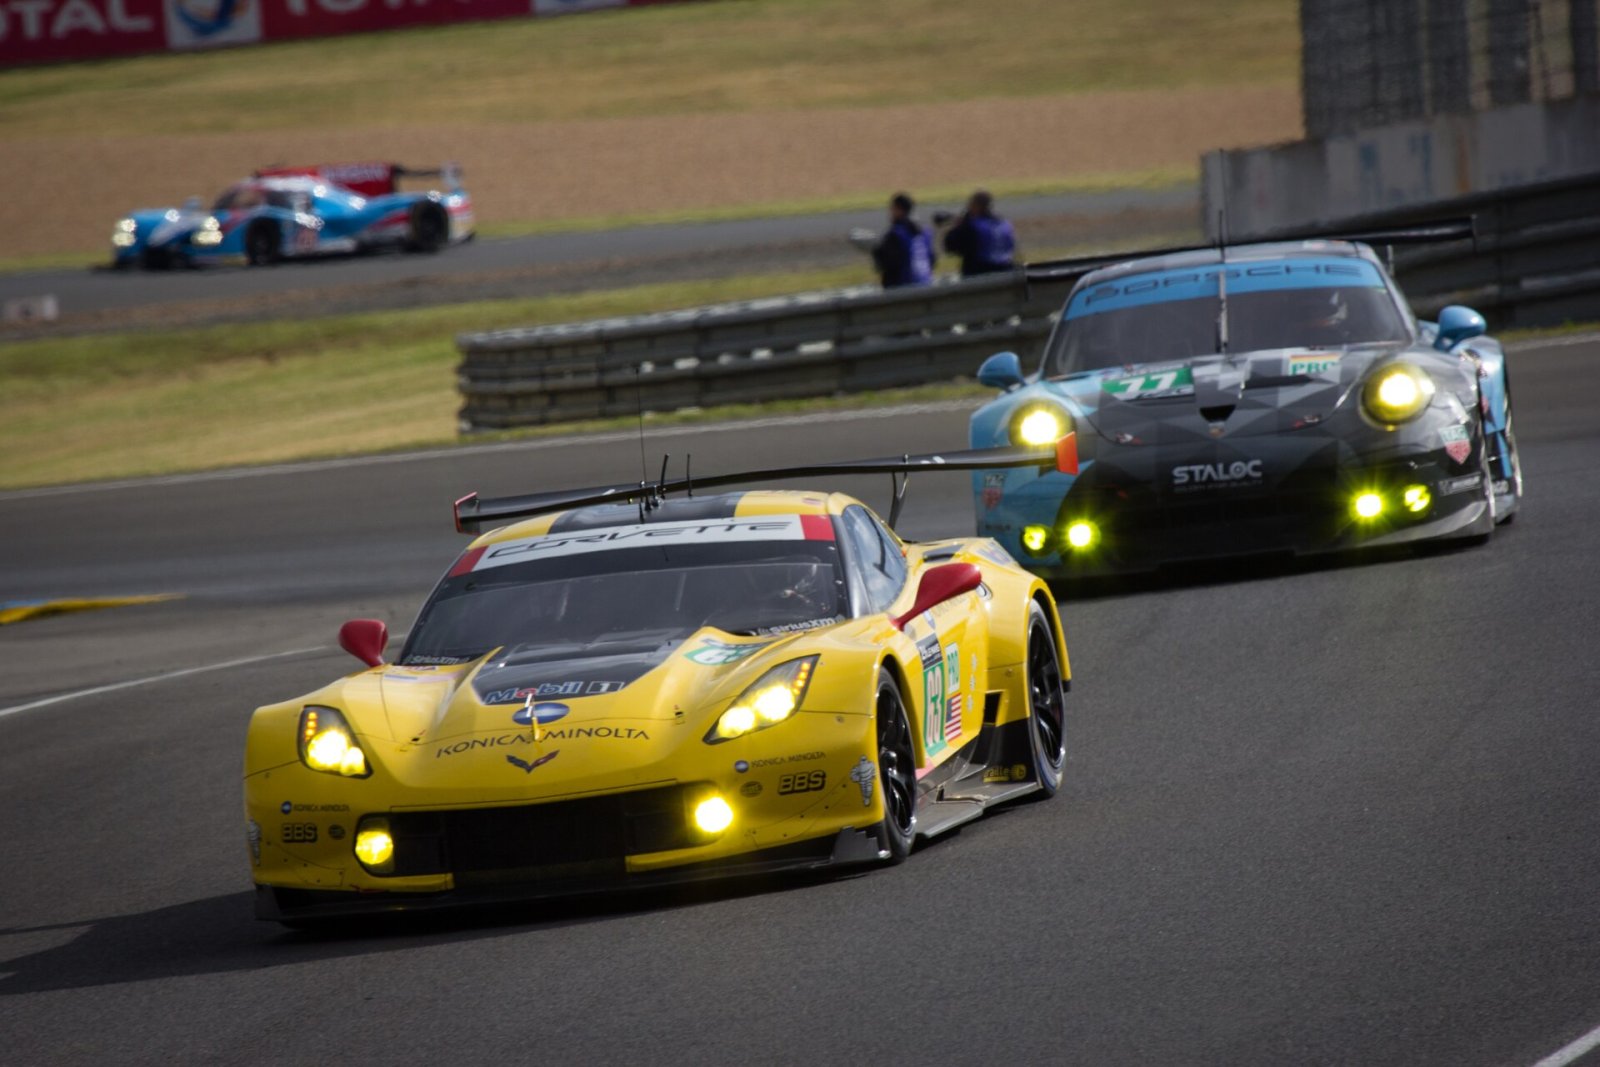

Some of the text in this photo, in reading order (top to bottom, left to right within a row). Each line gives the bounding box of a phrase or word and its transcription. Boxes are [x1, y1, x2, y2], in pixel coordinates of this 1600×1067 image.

[0, 0, 154, 41] TAL
[1085, 264, 1362, 306] PORSCHE
[1117, 371, 1178, 400] 77
[1172, 459, 1263, 484] STALOC
[487, 521, 792, 559] CORVETTE
[484, 681, 584, 704] Mobil
[436, 727, 650, 758] KONICA MINOLTA
[778, 770, 827, 795] BBS
